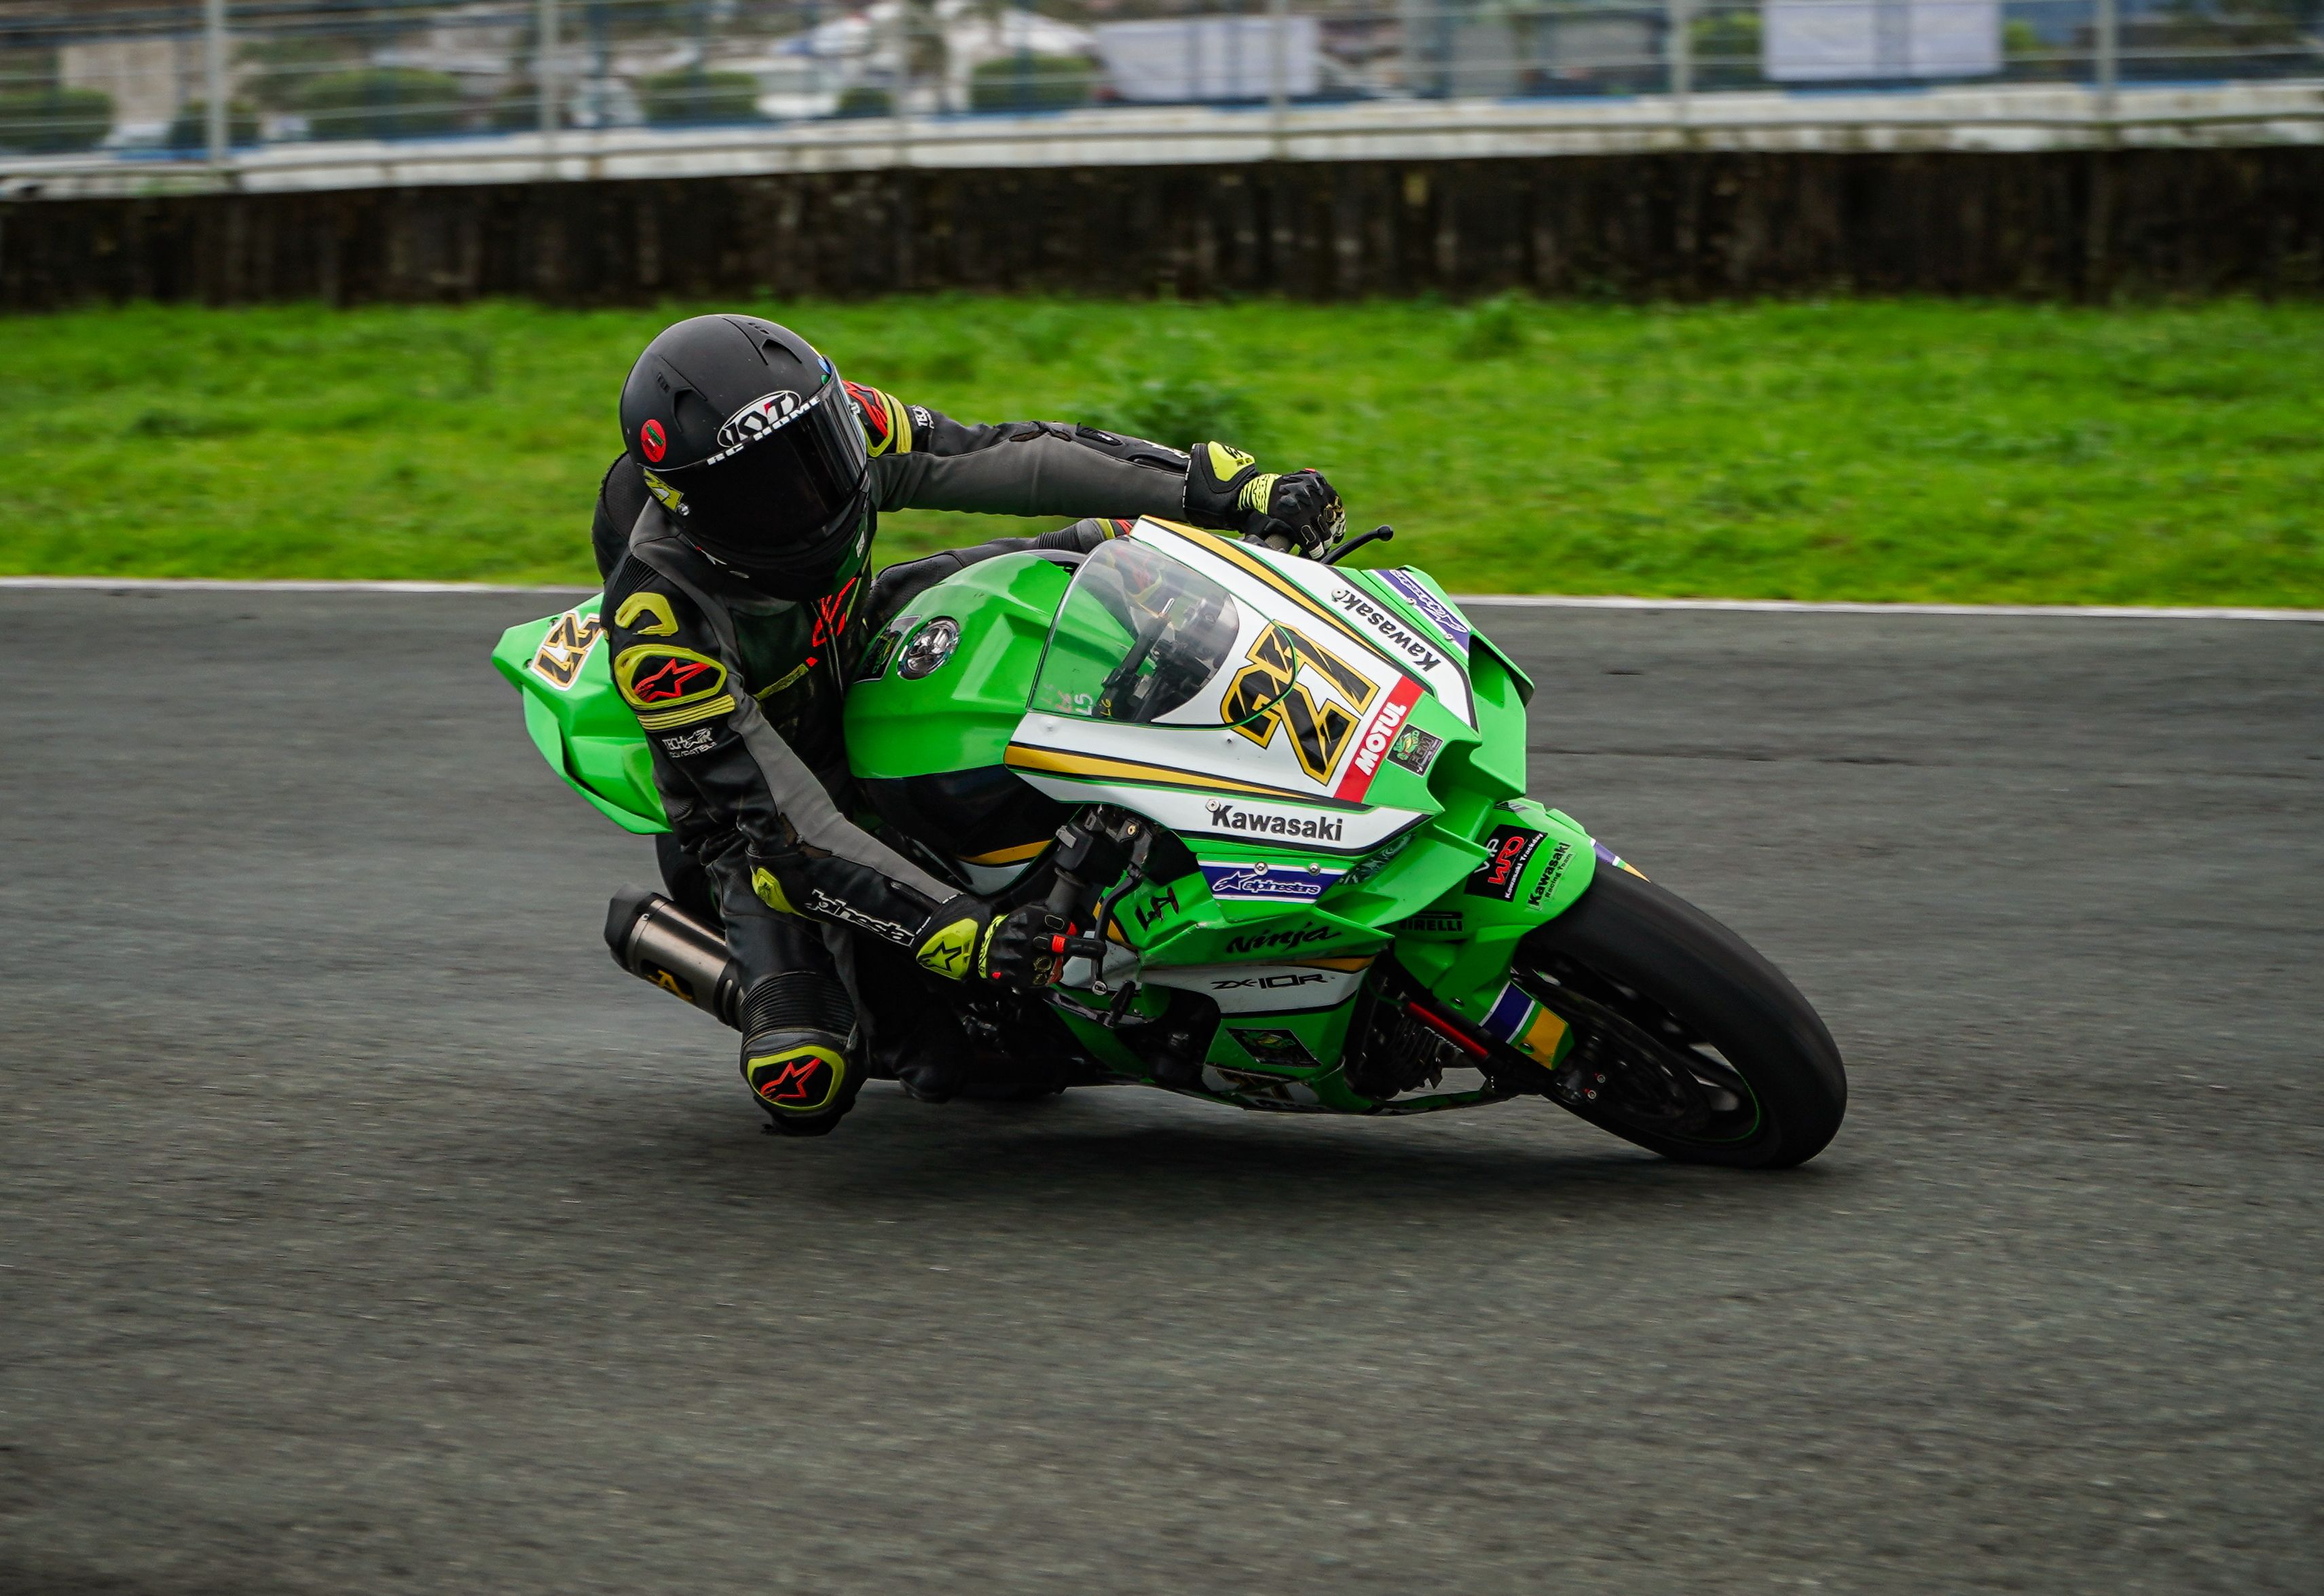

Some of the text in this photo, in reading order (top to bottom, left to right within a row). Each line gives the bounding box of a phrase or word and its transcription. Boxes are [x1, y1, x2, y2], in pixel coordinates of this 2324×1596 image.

[722, 392, 787, 446] KYT
[707, 443, 745, 466] RC
[1331, 590, 1441, 672] Kawasaki
[1219, 619, 1380, 786] 21
[1354, 702, 1407, 776] MOTUL
[1211, 805, 1343, 841] Kawasaki
[1473, 838, 1499, 873] VP
[1504, 833, 1544, 899] Kawasaki Trackday
[1242, 879, 1321, 894] alpinestars
[1528, 841, 1571, 907] Kawasaki
[1545, 871, 1562, 899] Racing
[1226, 921, 1342, 954] Ninja
[1211, 973, 1329, 990] ZX-10R
